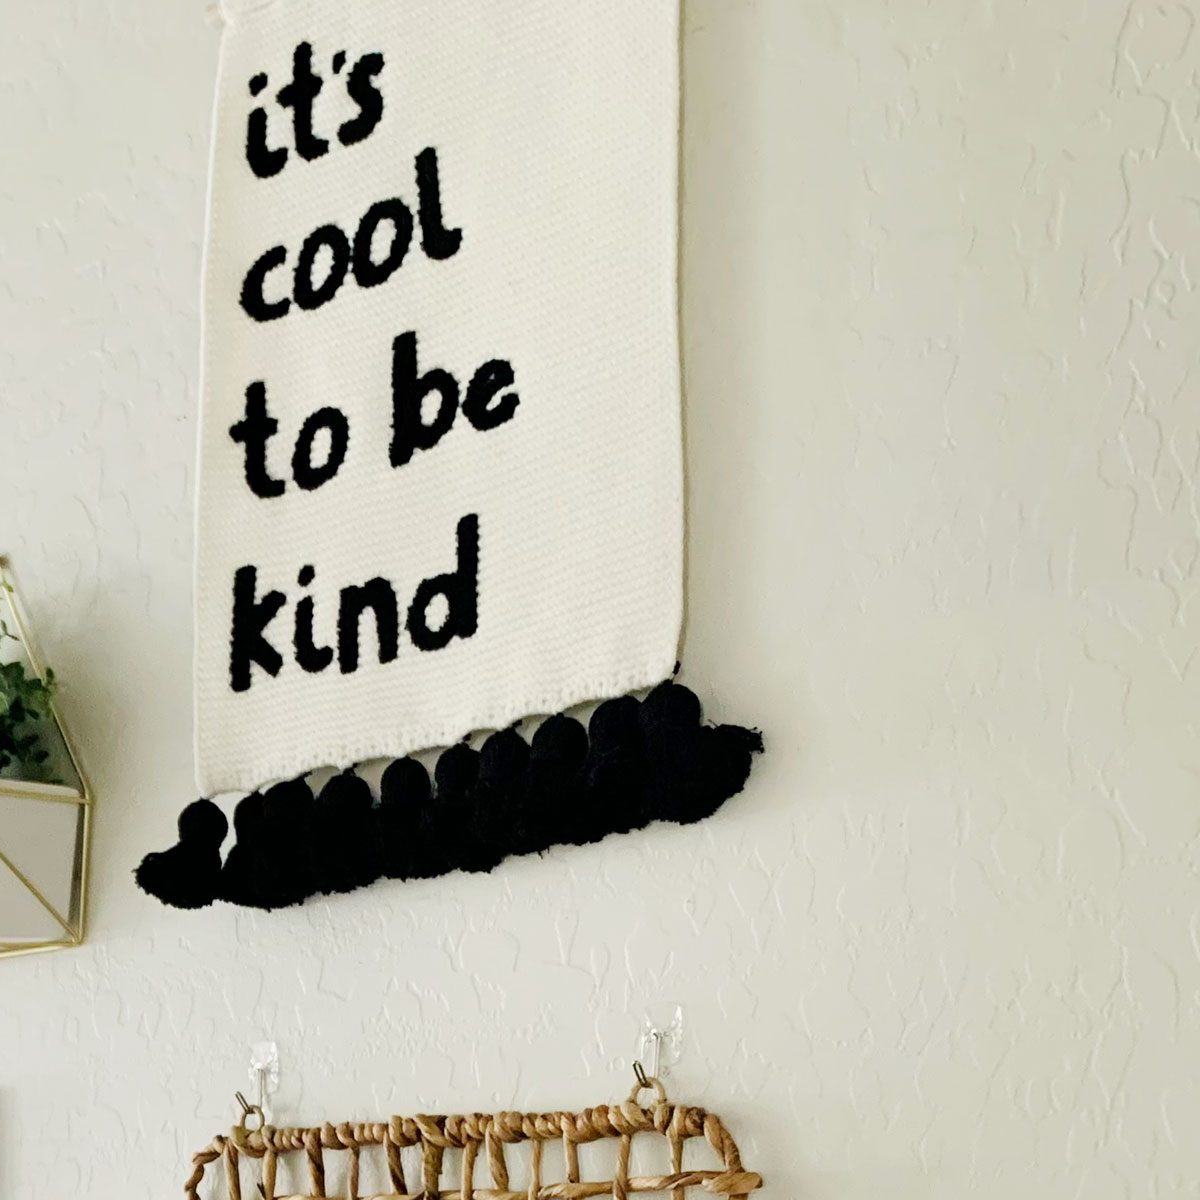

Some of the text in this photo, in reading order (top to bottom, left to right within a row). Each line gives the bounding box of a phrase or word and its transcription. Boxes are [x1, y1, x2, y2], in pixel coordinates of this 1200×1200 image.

[246, 41, 384, 178] it's
[240, 147, 462, 322] cool
[229, 330, 520, 499] to be
[229, 513, 478, 692] kind
